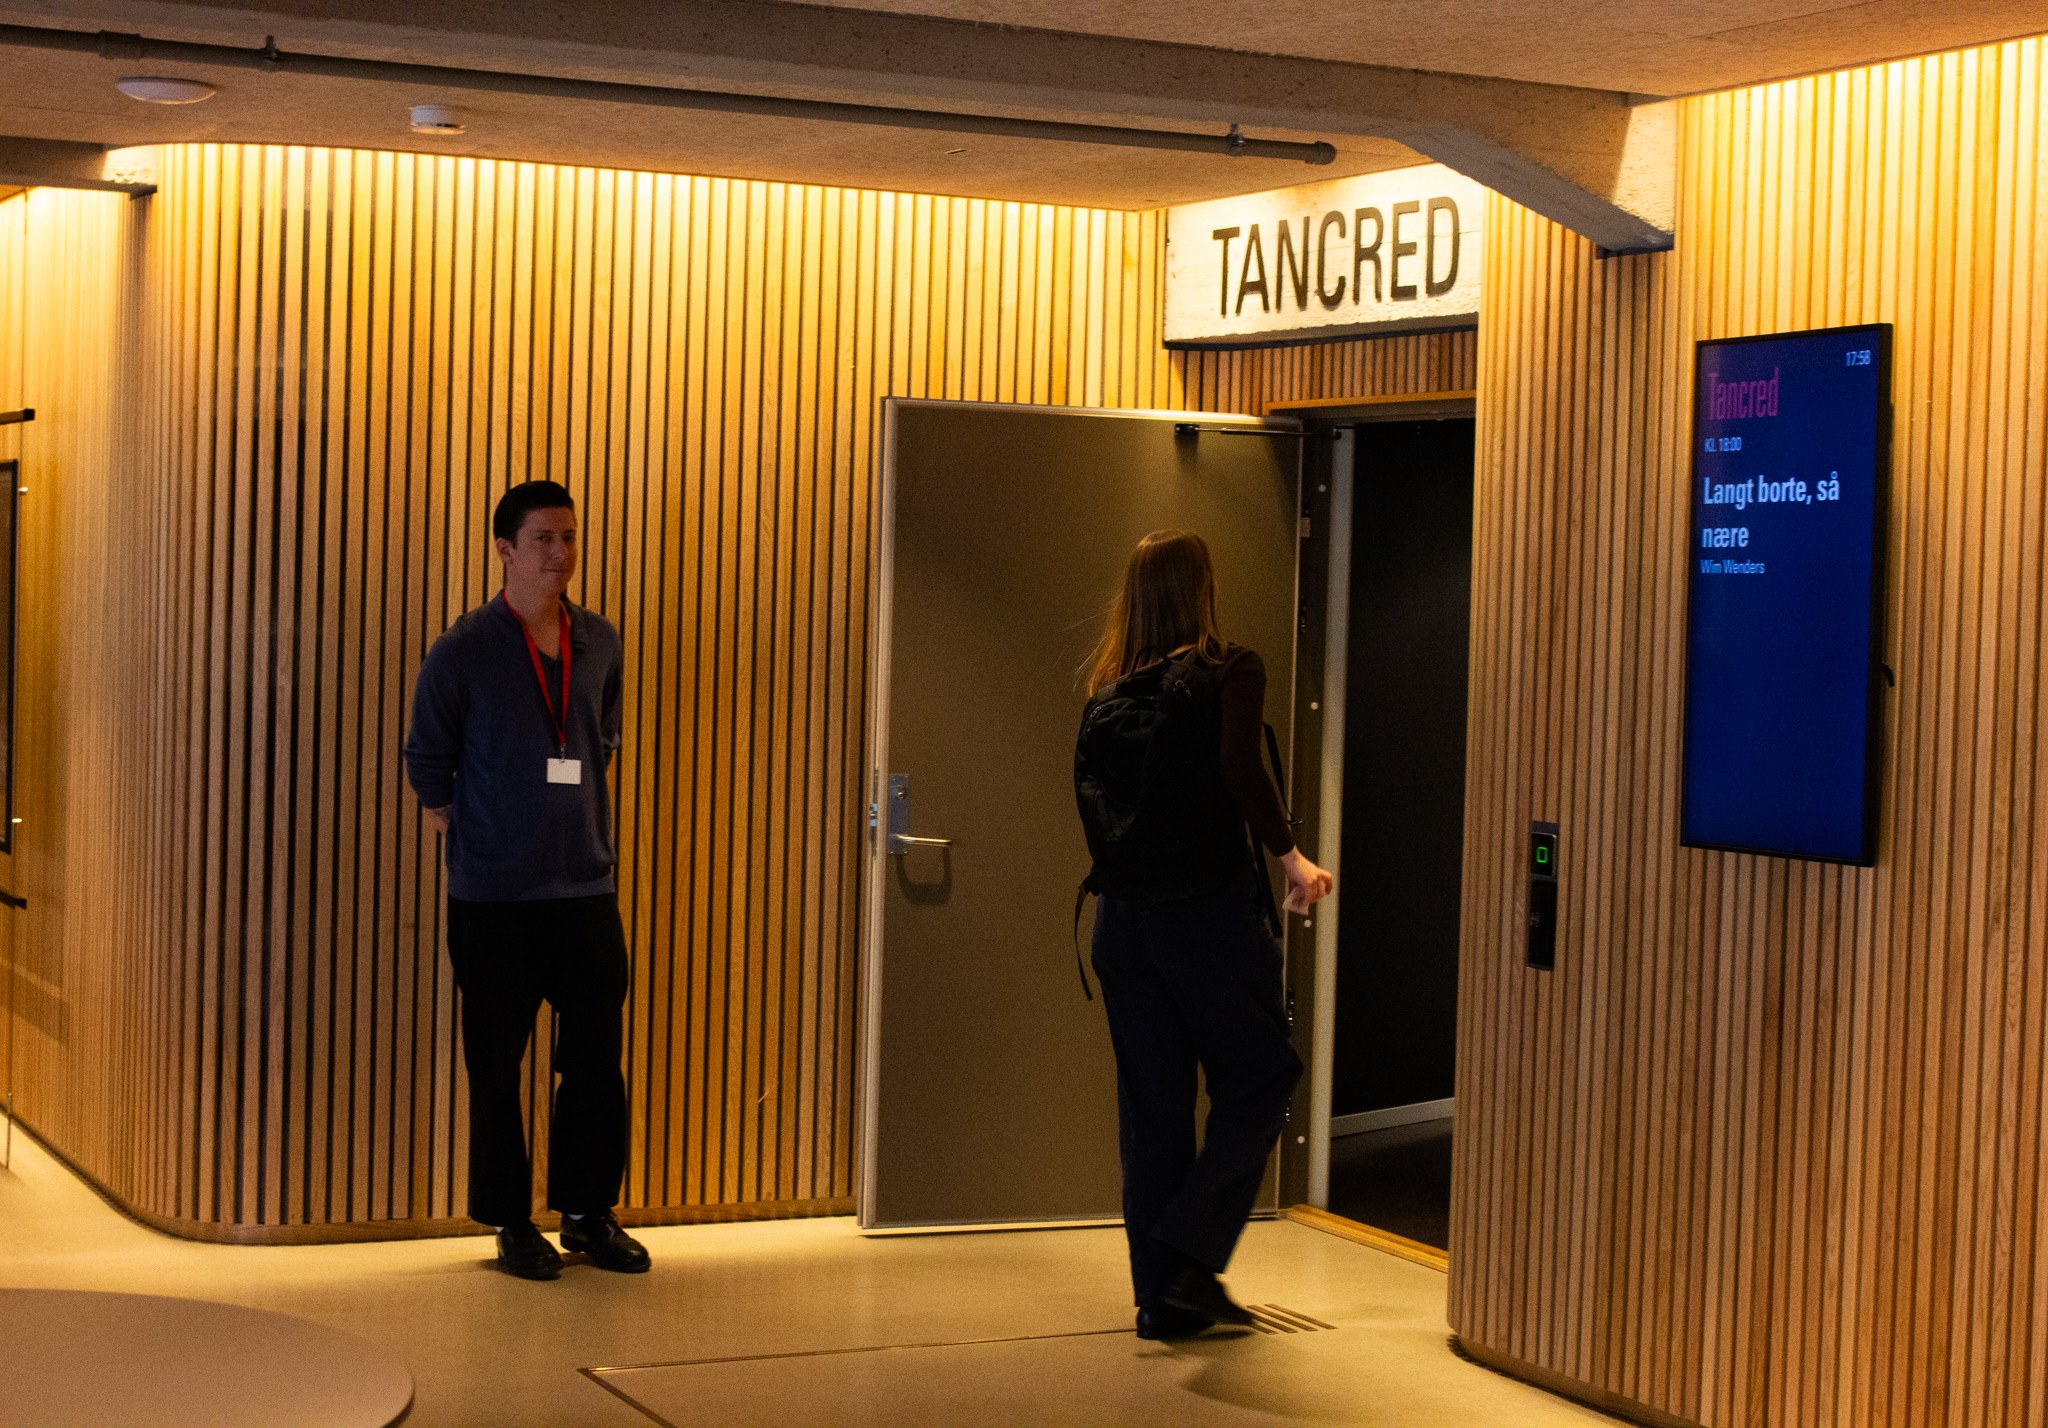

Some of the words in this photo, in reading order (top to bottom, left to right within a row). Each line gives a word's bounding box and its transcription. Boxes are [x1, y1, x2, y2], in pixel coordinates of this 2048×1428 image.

[1213, 196, 1460, 318] TANCRED
[1845, 350, 1872, 367] 17:58
[1708, 367, 1779, 420] Tancred
[1719, 437, 1742, 451] 18:00
[1703, 477, 1754, 510] Langt
[1758, 475, 1812, 505] borte,
[1817, 471, 1840, 501] så
[1701, 527, 1749, 548] nære
[1700, 560, 1722, 574] Wim
[1723, 559, 1766, 574] Wenders
[1536, 846, 1548, 863] 0
